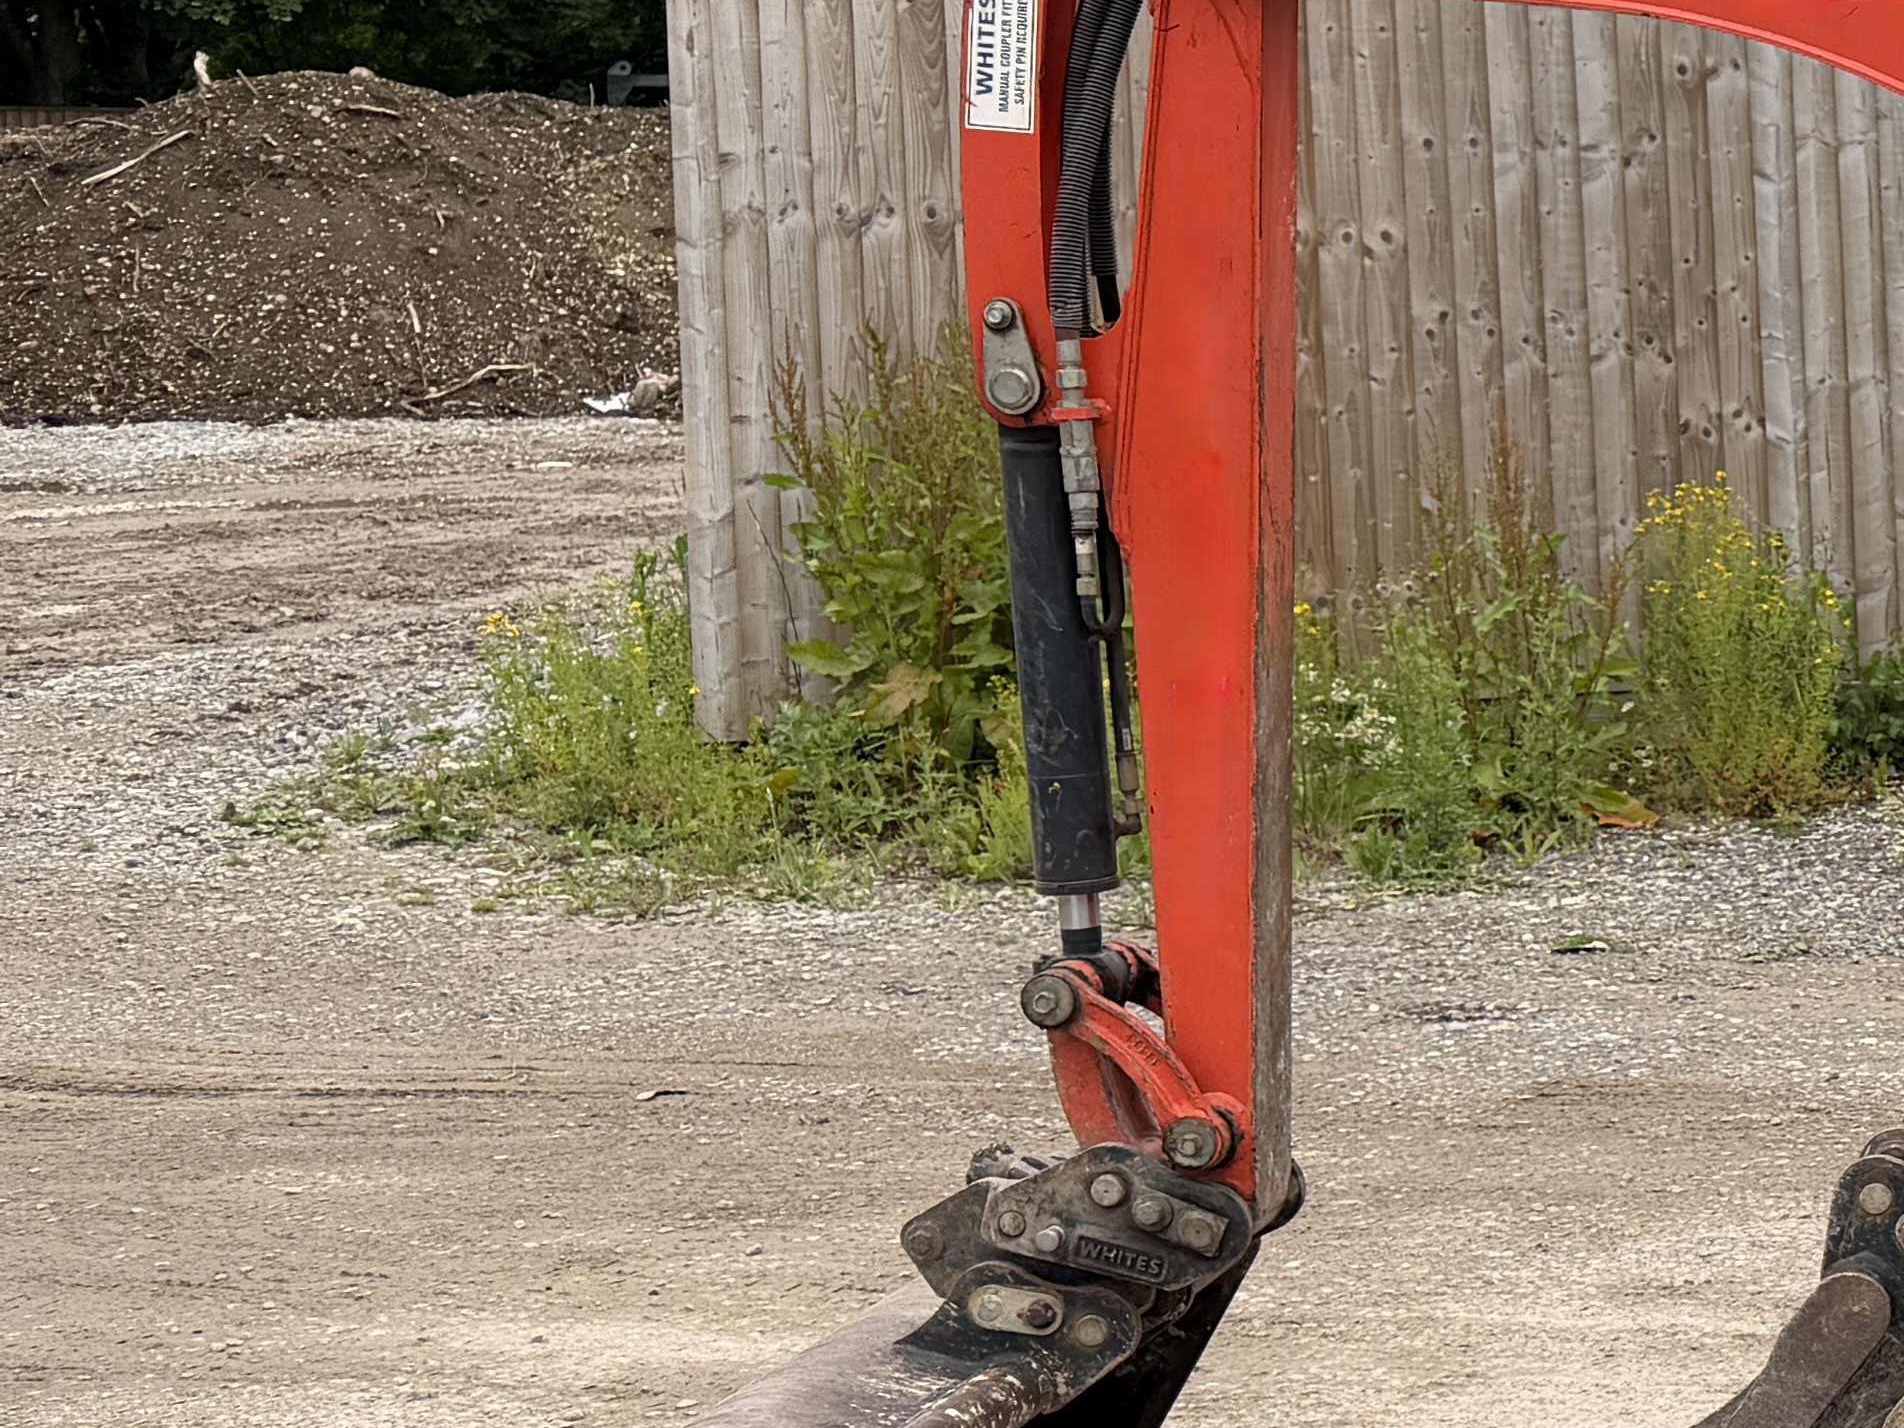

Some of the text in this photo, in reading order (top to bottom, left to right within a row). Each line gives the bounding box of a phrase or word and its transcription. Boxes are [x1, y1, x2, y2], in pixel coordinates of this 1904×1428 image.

[999, 19, 1013, 67] COUPLER
[998, 71, 1010, 113] MANUAL
[1013, 67, 1026, 105] SAFETY
[1080, 1240, 1161, 1274] WHITES
